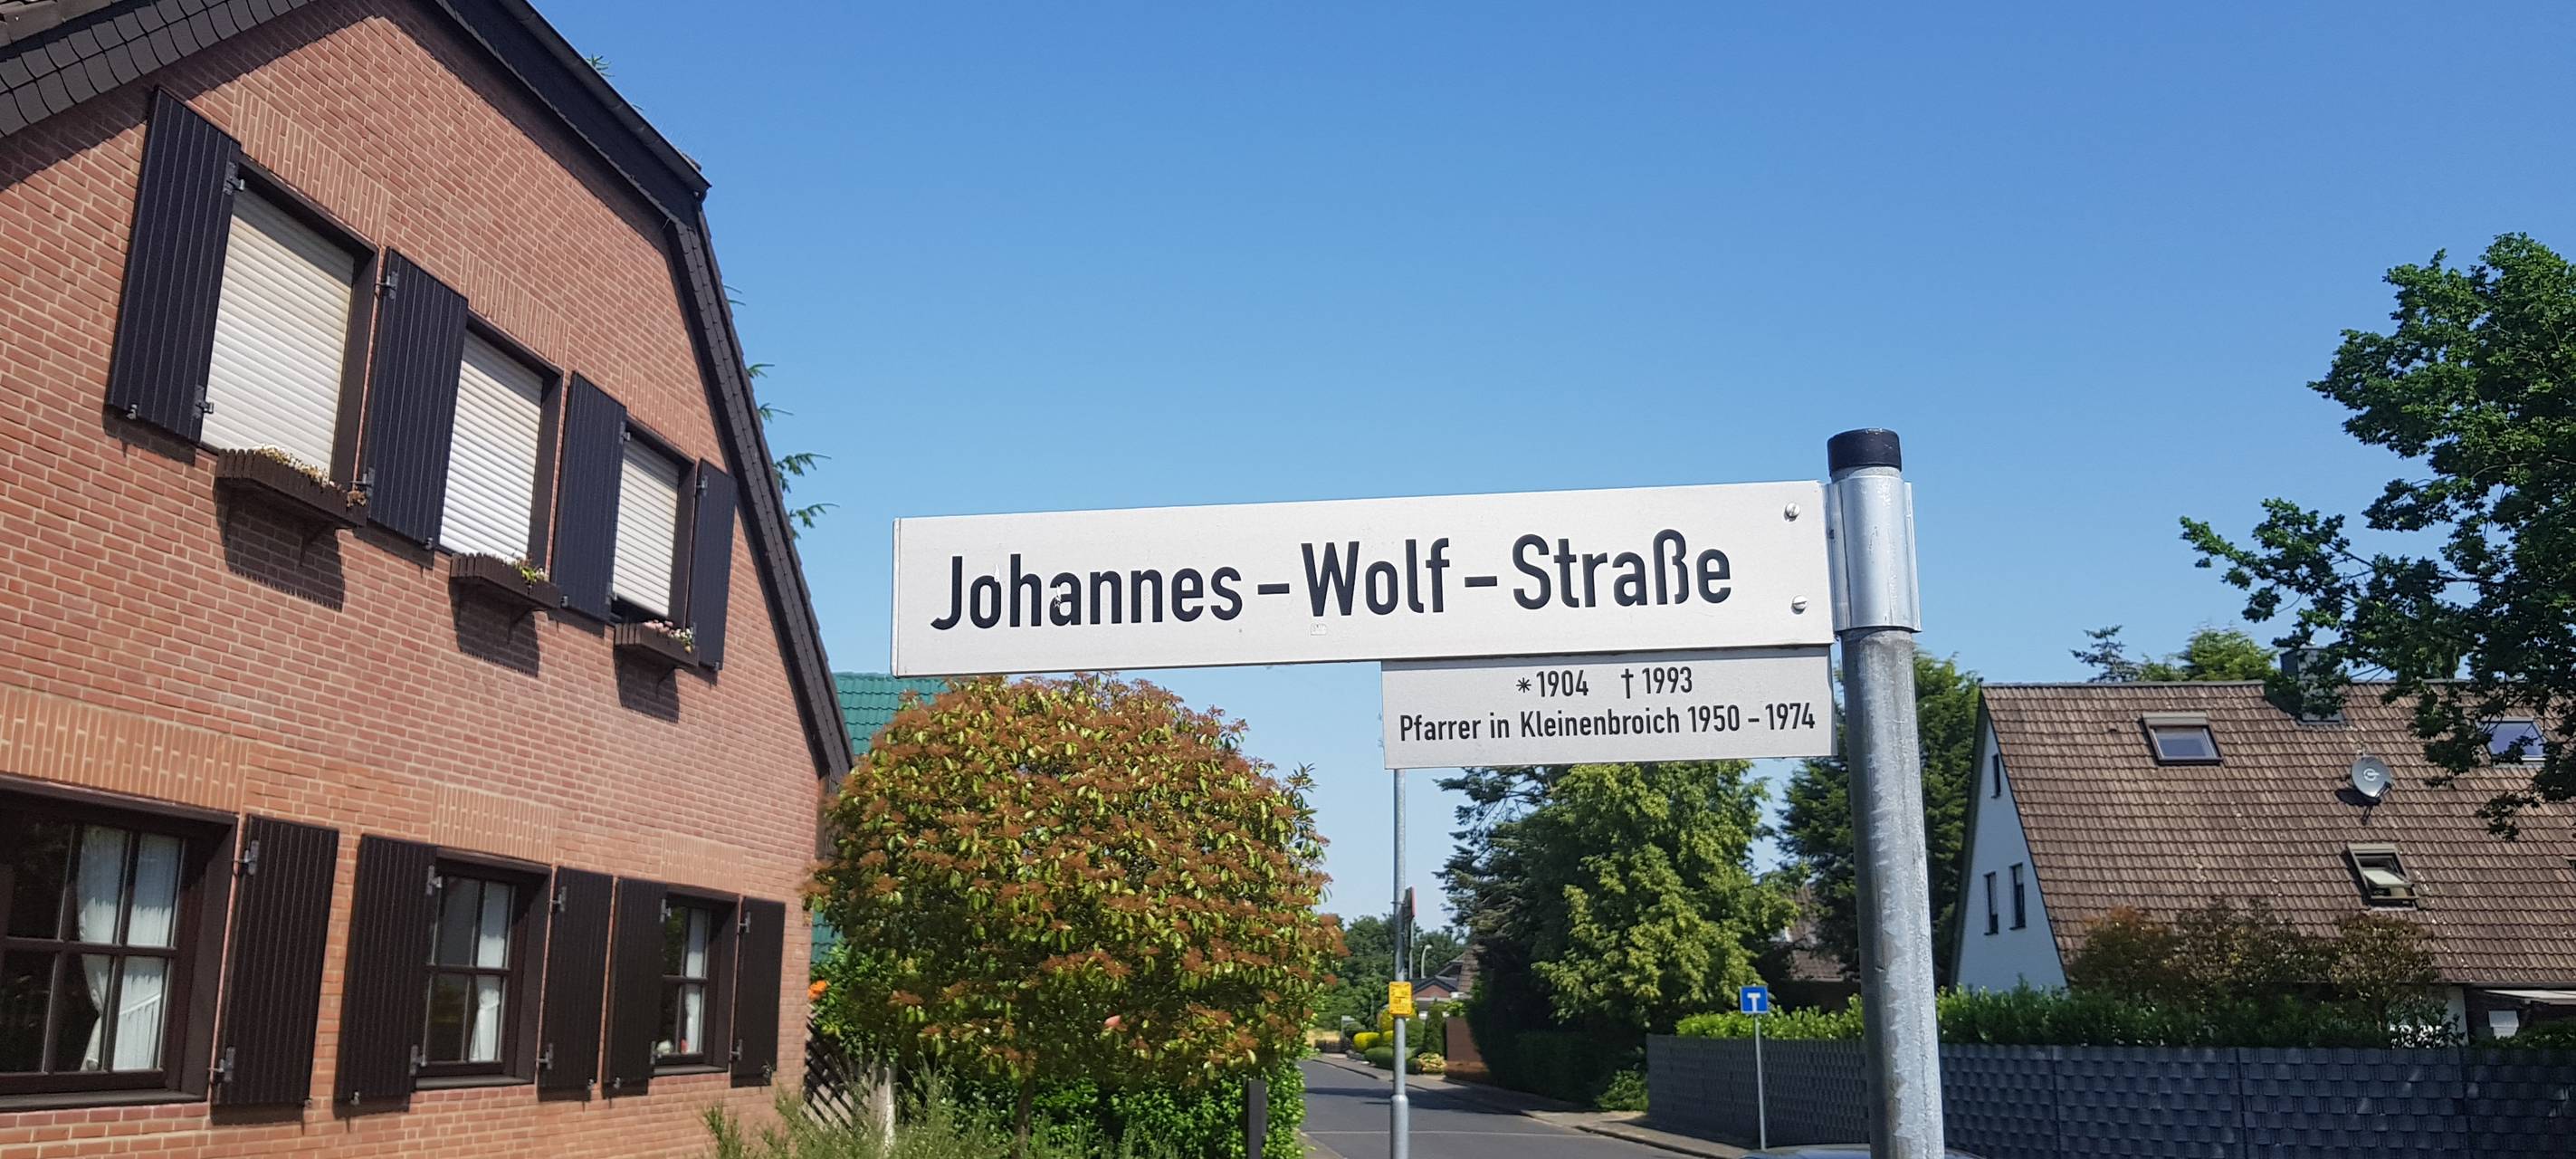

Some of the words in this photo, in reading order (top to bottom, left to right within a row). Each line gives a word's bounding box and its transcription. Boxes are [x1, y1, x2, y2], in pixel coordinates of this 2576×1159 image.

[1399, 714, 1483, 742] Pfarrer
[1489, 712, 1511, 739] in
[1520, 706, 1681, 738] Kleinenbroich
